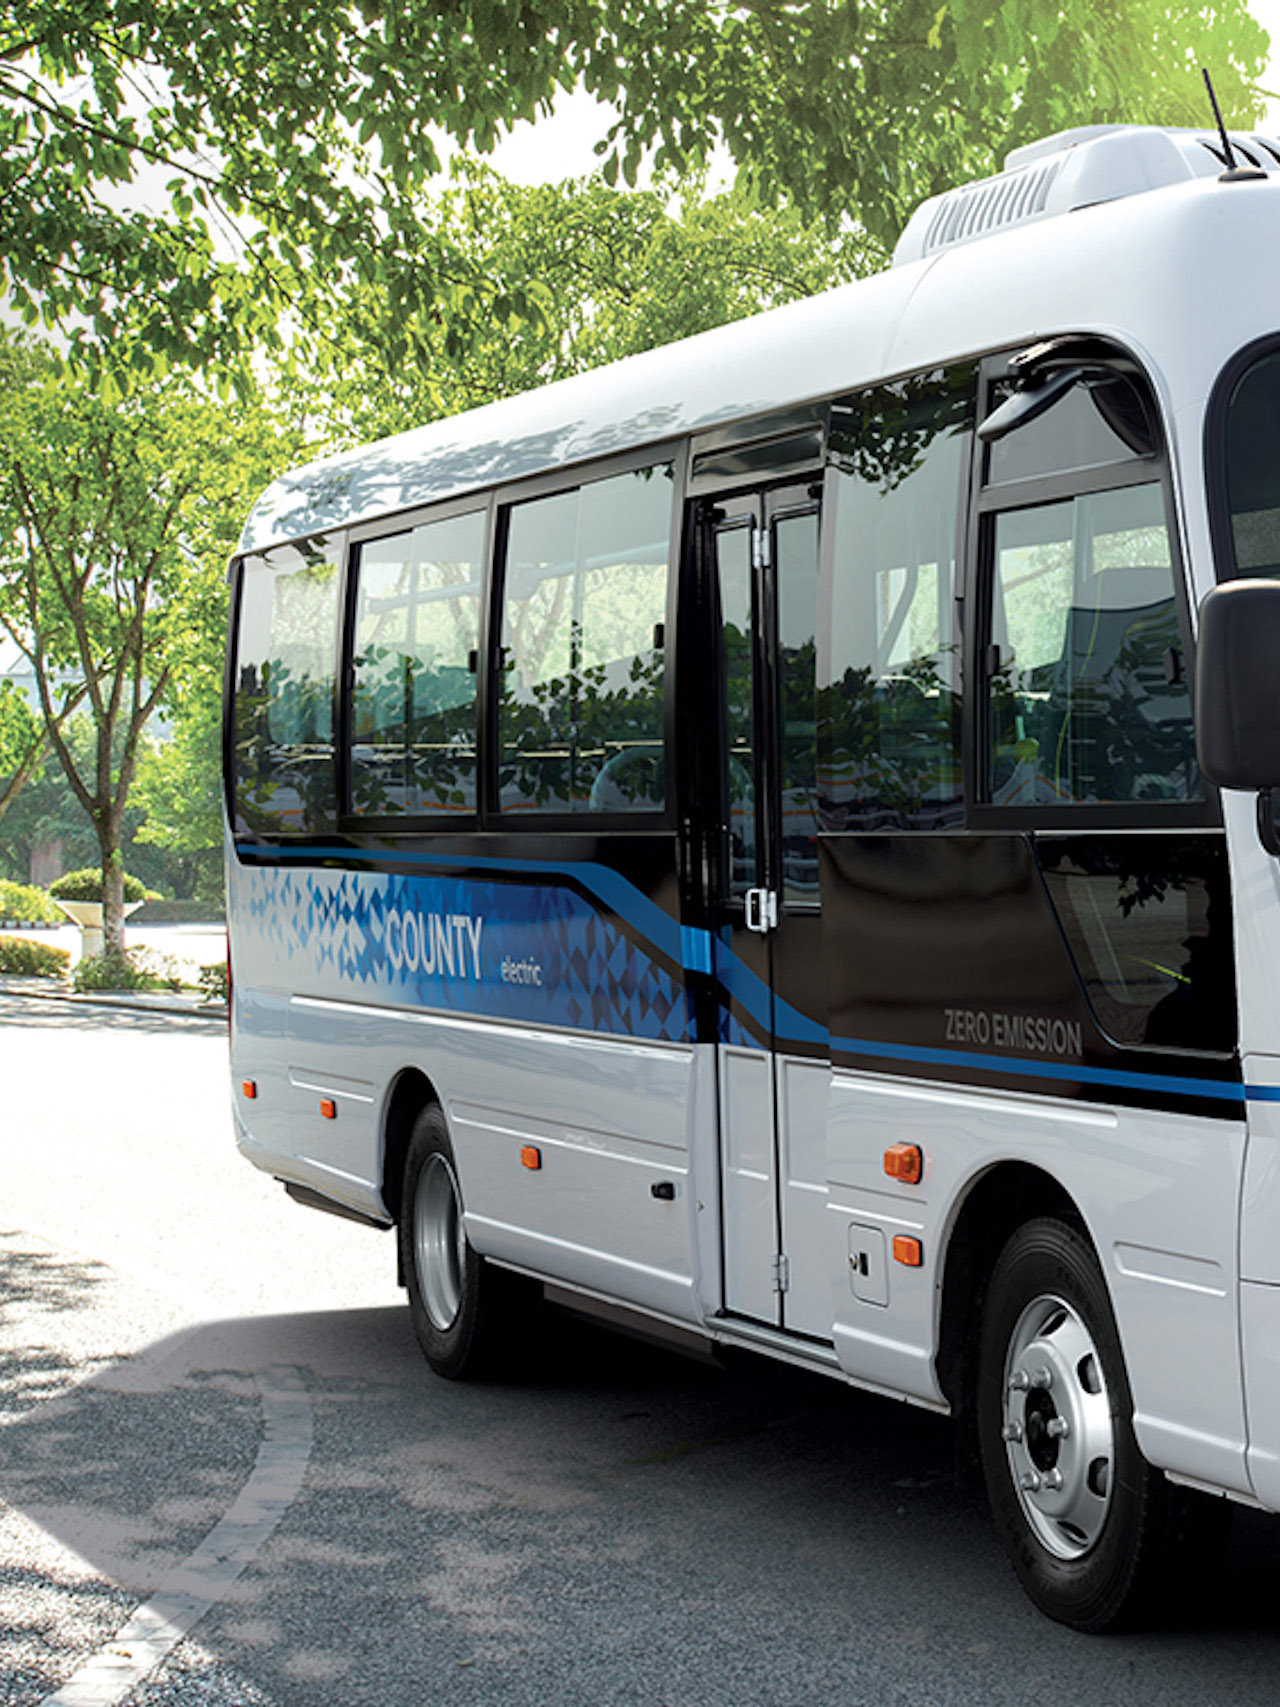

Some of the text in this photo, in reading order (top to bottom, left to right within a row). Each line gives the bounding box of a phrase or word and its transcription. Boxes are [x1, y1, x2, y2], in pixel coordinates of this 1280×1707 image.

[385, 910, 543, 986] COUNTY electric
[944, 1009, 1082, 1056] ZERO EMISSION
